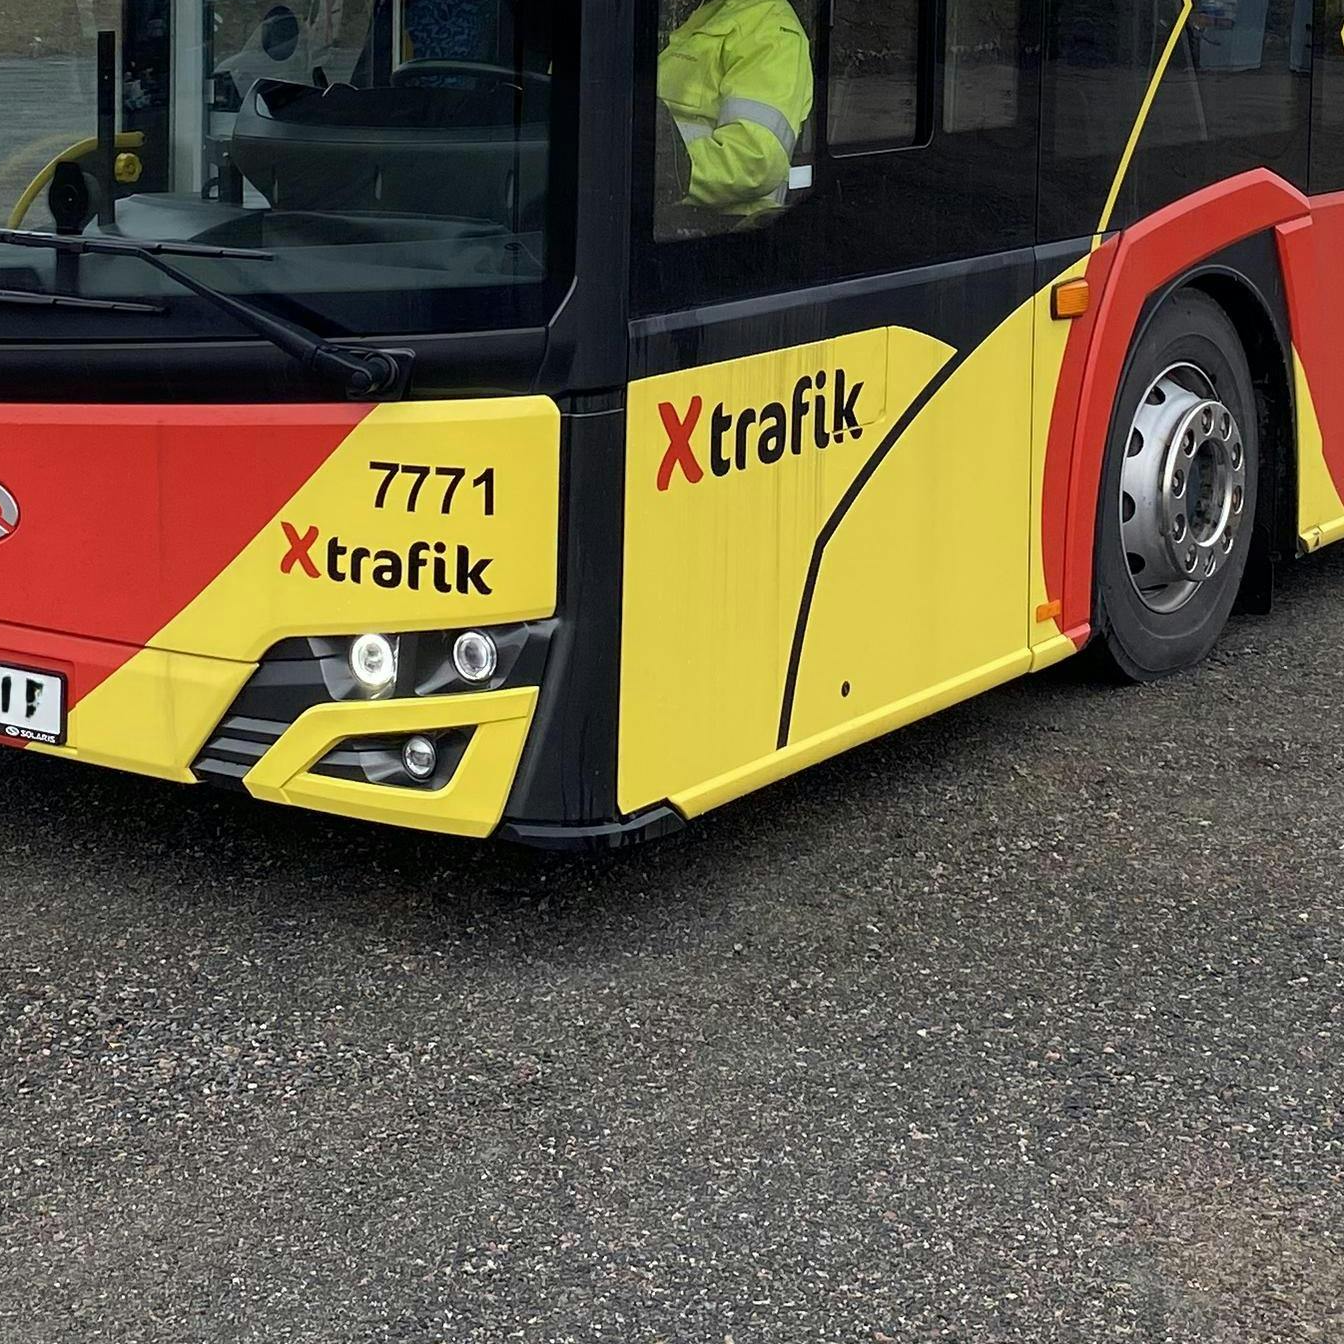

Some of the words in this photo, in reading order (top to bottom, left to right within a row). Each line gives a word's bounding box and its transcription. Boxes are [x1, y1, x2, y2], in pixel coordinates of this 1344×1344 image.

[656, 368, 865, 492] Xtrafik
[369, 460, 495, 516] 7771
[279, 521, 495, 596] Xtrafik
[20, 729, 56, 743] SOLARIS
